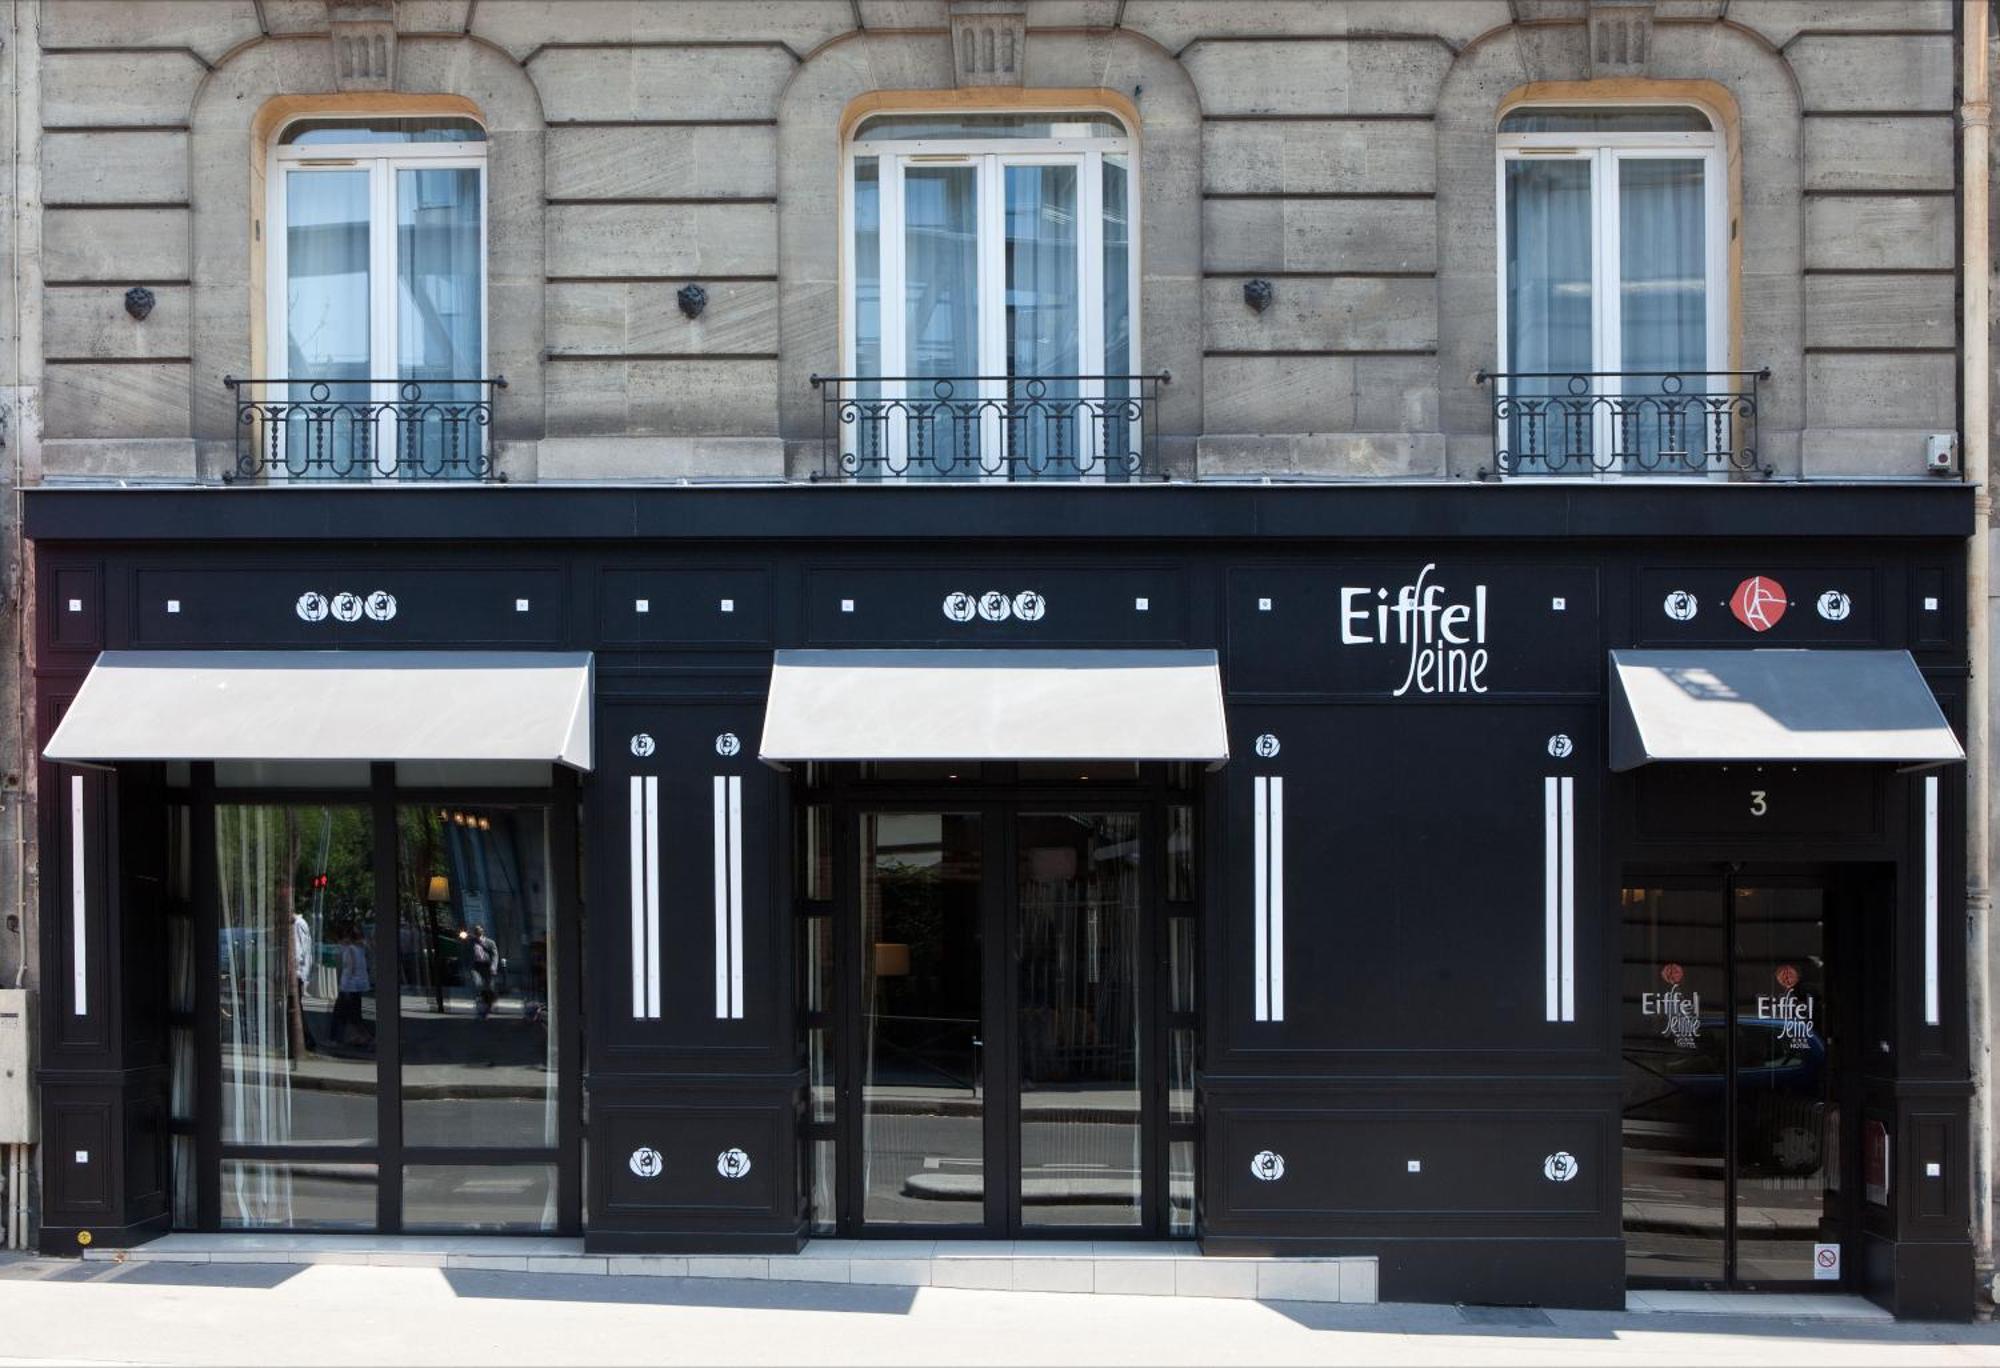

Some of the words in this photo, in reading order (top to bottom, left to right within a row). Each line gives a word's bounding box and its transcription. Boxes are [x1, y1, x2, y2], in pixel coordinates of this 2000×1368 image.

[1340, 584, 1487, 645] Eiffel
[1750, 790, 1767, 816] 3
[1642, 991, 1699, 1015] Eiffel
[1758, 996, 1813, 1020] Eiffel
